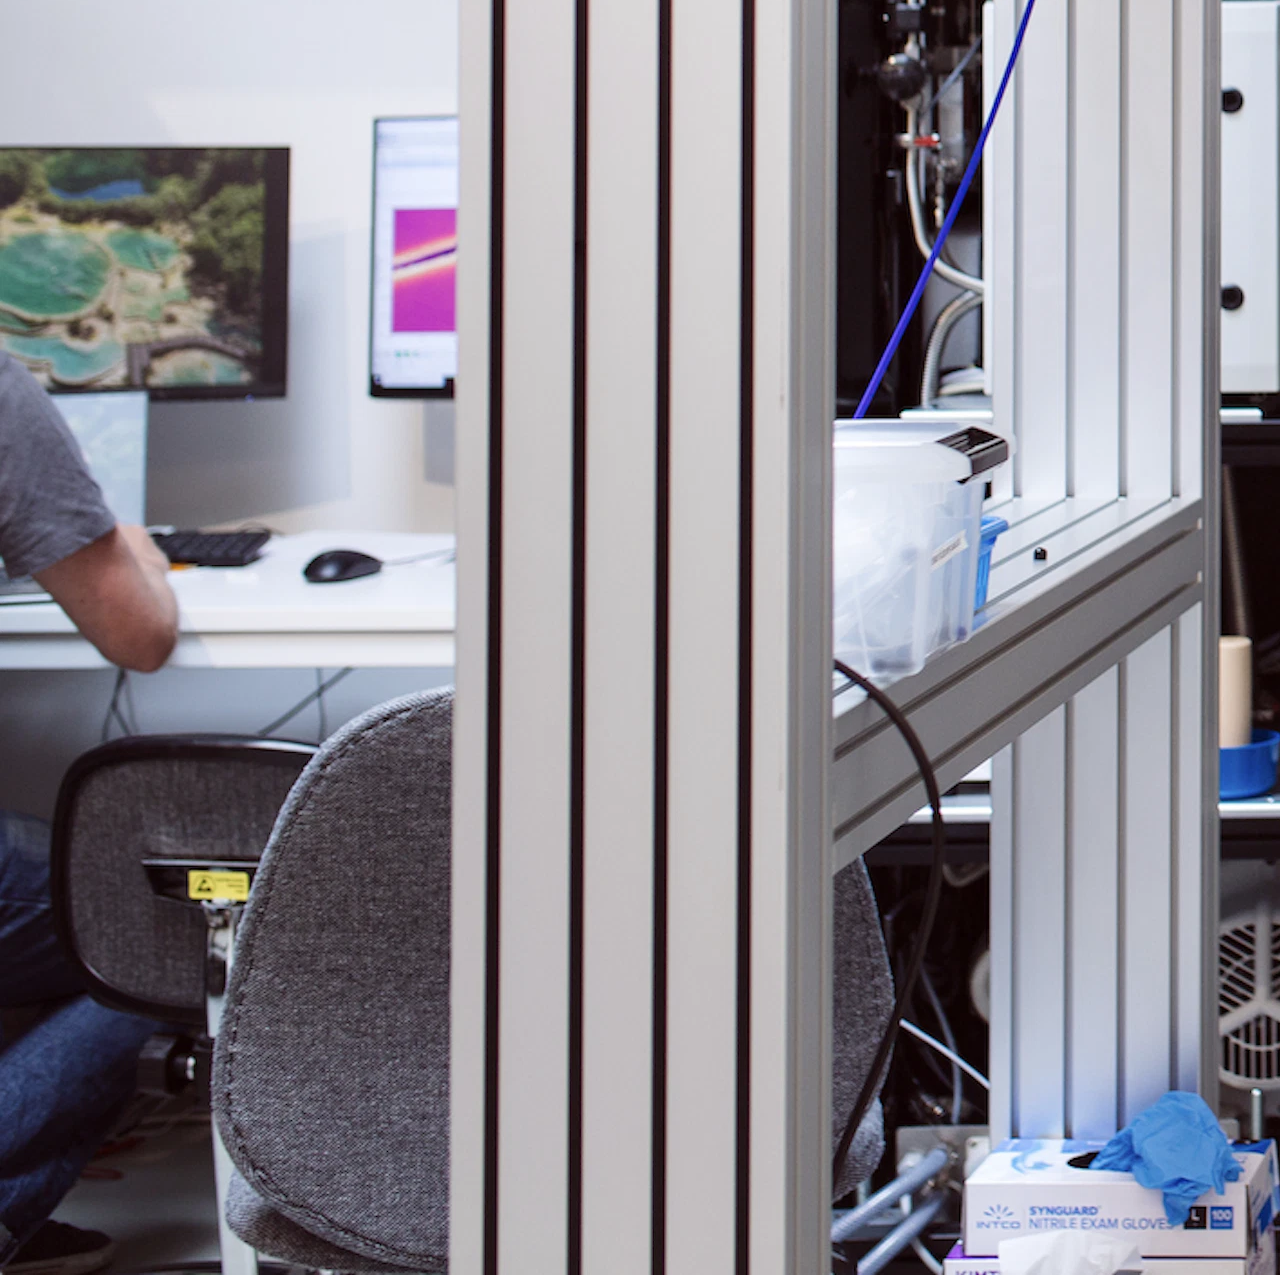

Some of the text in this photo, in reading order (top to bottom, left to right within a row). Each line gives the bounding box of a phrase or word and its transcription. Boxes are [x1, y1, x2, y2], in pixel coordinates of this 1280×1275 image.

[1029, 1206, 1098, 1216] SYNGUARD
[1191, 1208, 1200, 1221] L
[1211, 1209, 1233, 1221] 100
[976, 1220, 1021, 1230] INTCO
[1028, 1218, 1077, 1230] NITRILE
[1080, 1218, 1119, 1230] EXAM
